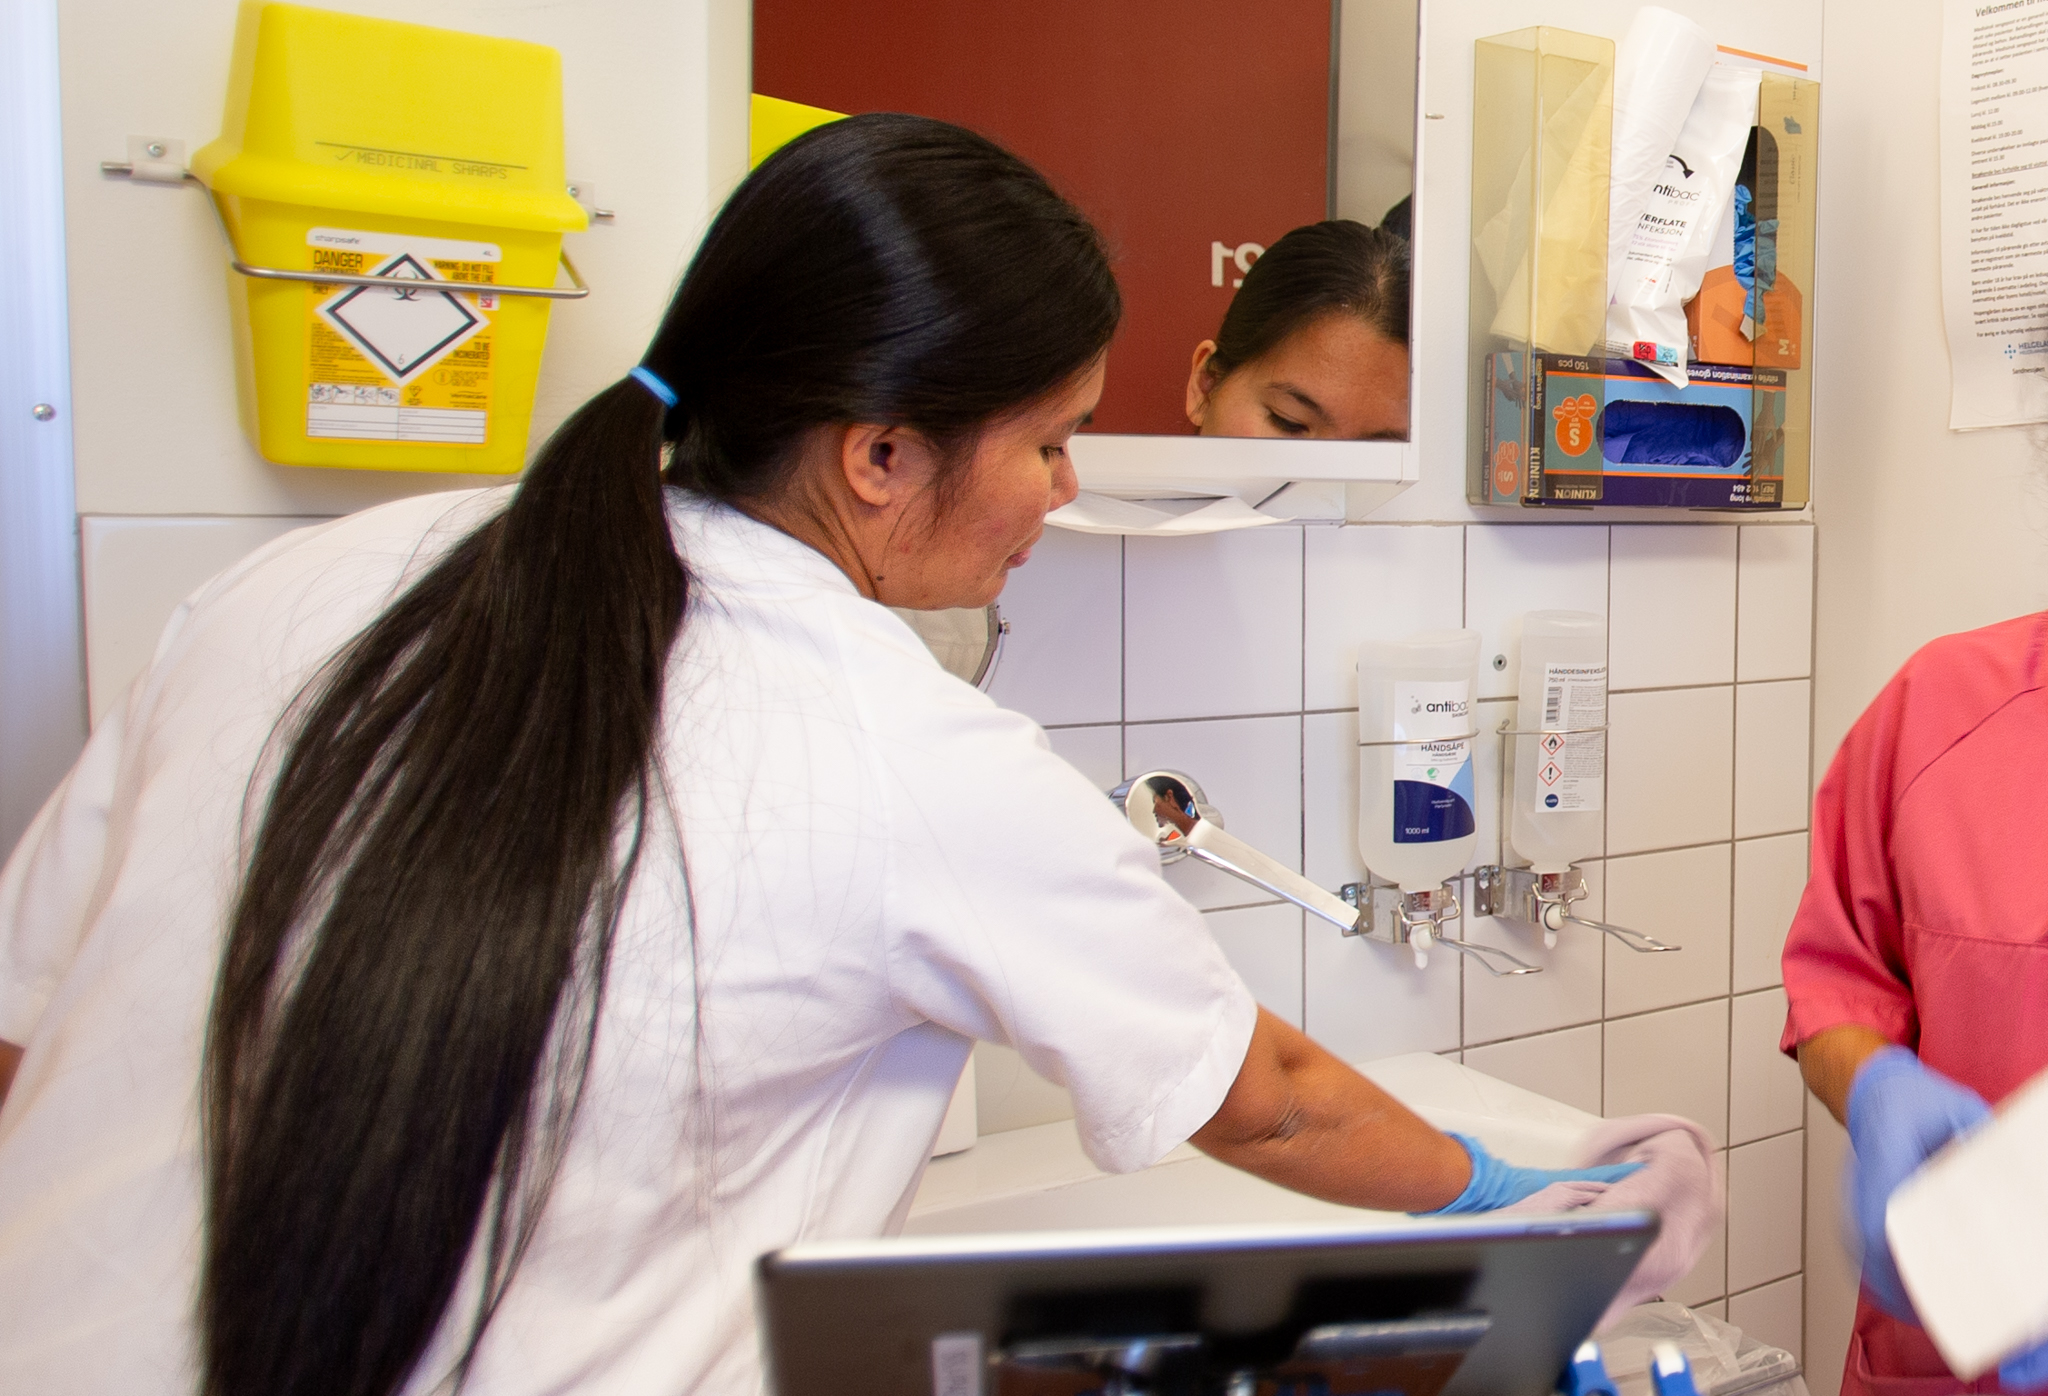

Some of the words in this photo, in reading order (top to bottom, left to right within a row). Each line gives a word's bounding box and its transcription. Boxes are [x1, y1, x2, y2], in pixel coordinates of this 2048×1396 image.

[1976, 0, 2024, 16] Velkommen
[356, 151, 442, 173] MEDICINAL
[453, 163, 507, 179] SHARPS
[313, 249, 363, 269] DANGER
[398, 354, 404, 364] 6
[1558, 358, 1573, 367] pcs
[1575, 361, 1589, 370] 150
[1686, 369, 1711, 380] gloves
[1569, 428, 1580, 446] S
[1528, 447, 1540, 498] KLINION
[1555, 489, 1597, 499] KLINION
[1730, 494, 1744, 502] long
[1421, 742, 1464, 752] HÅNDSÅPE
